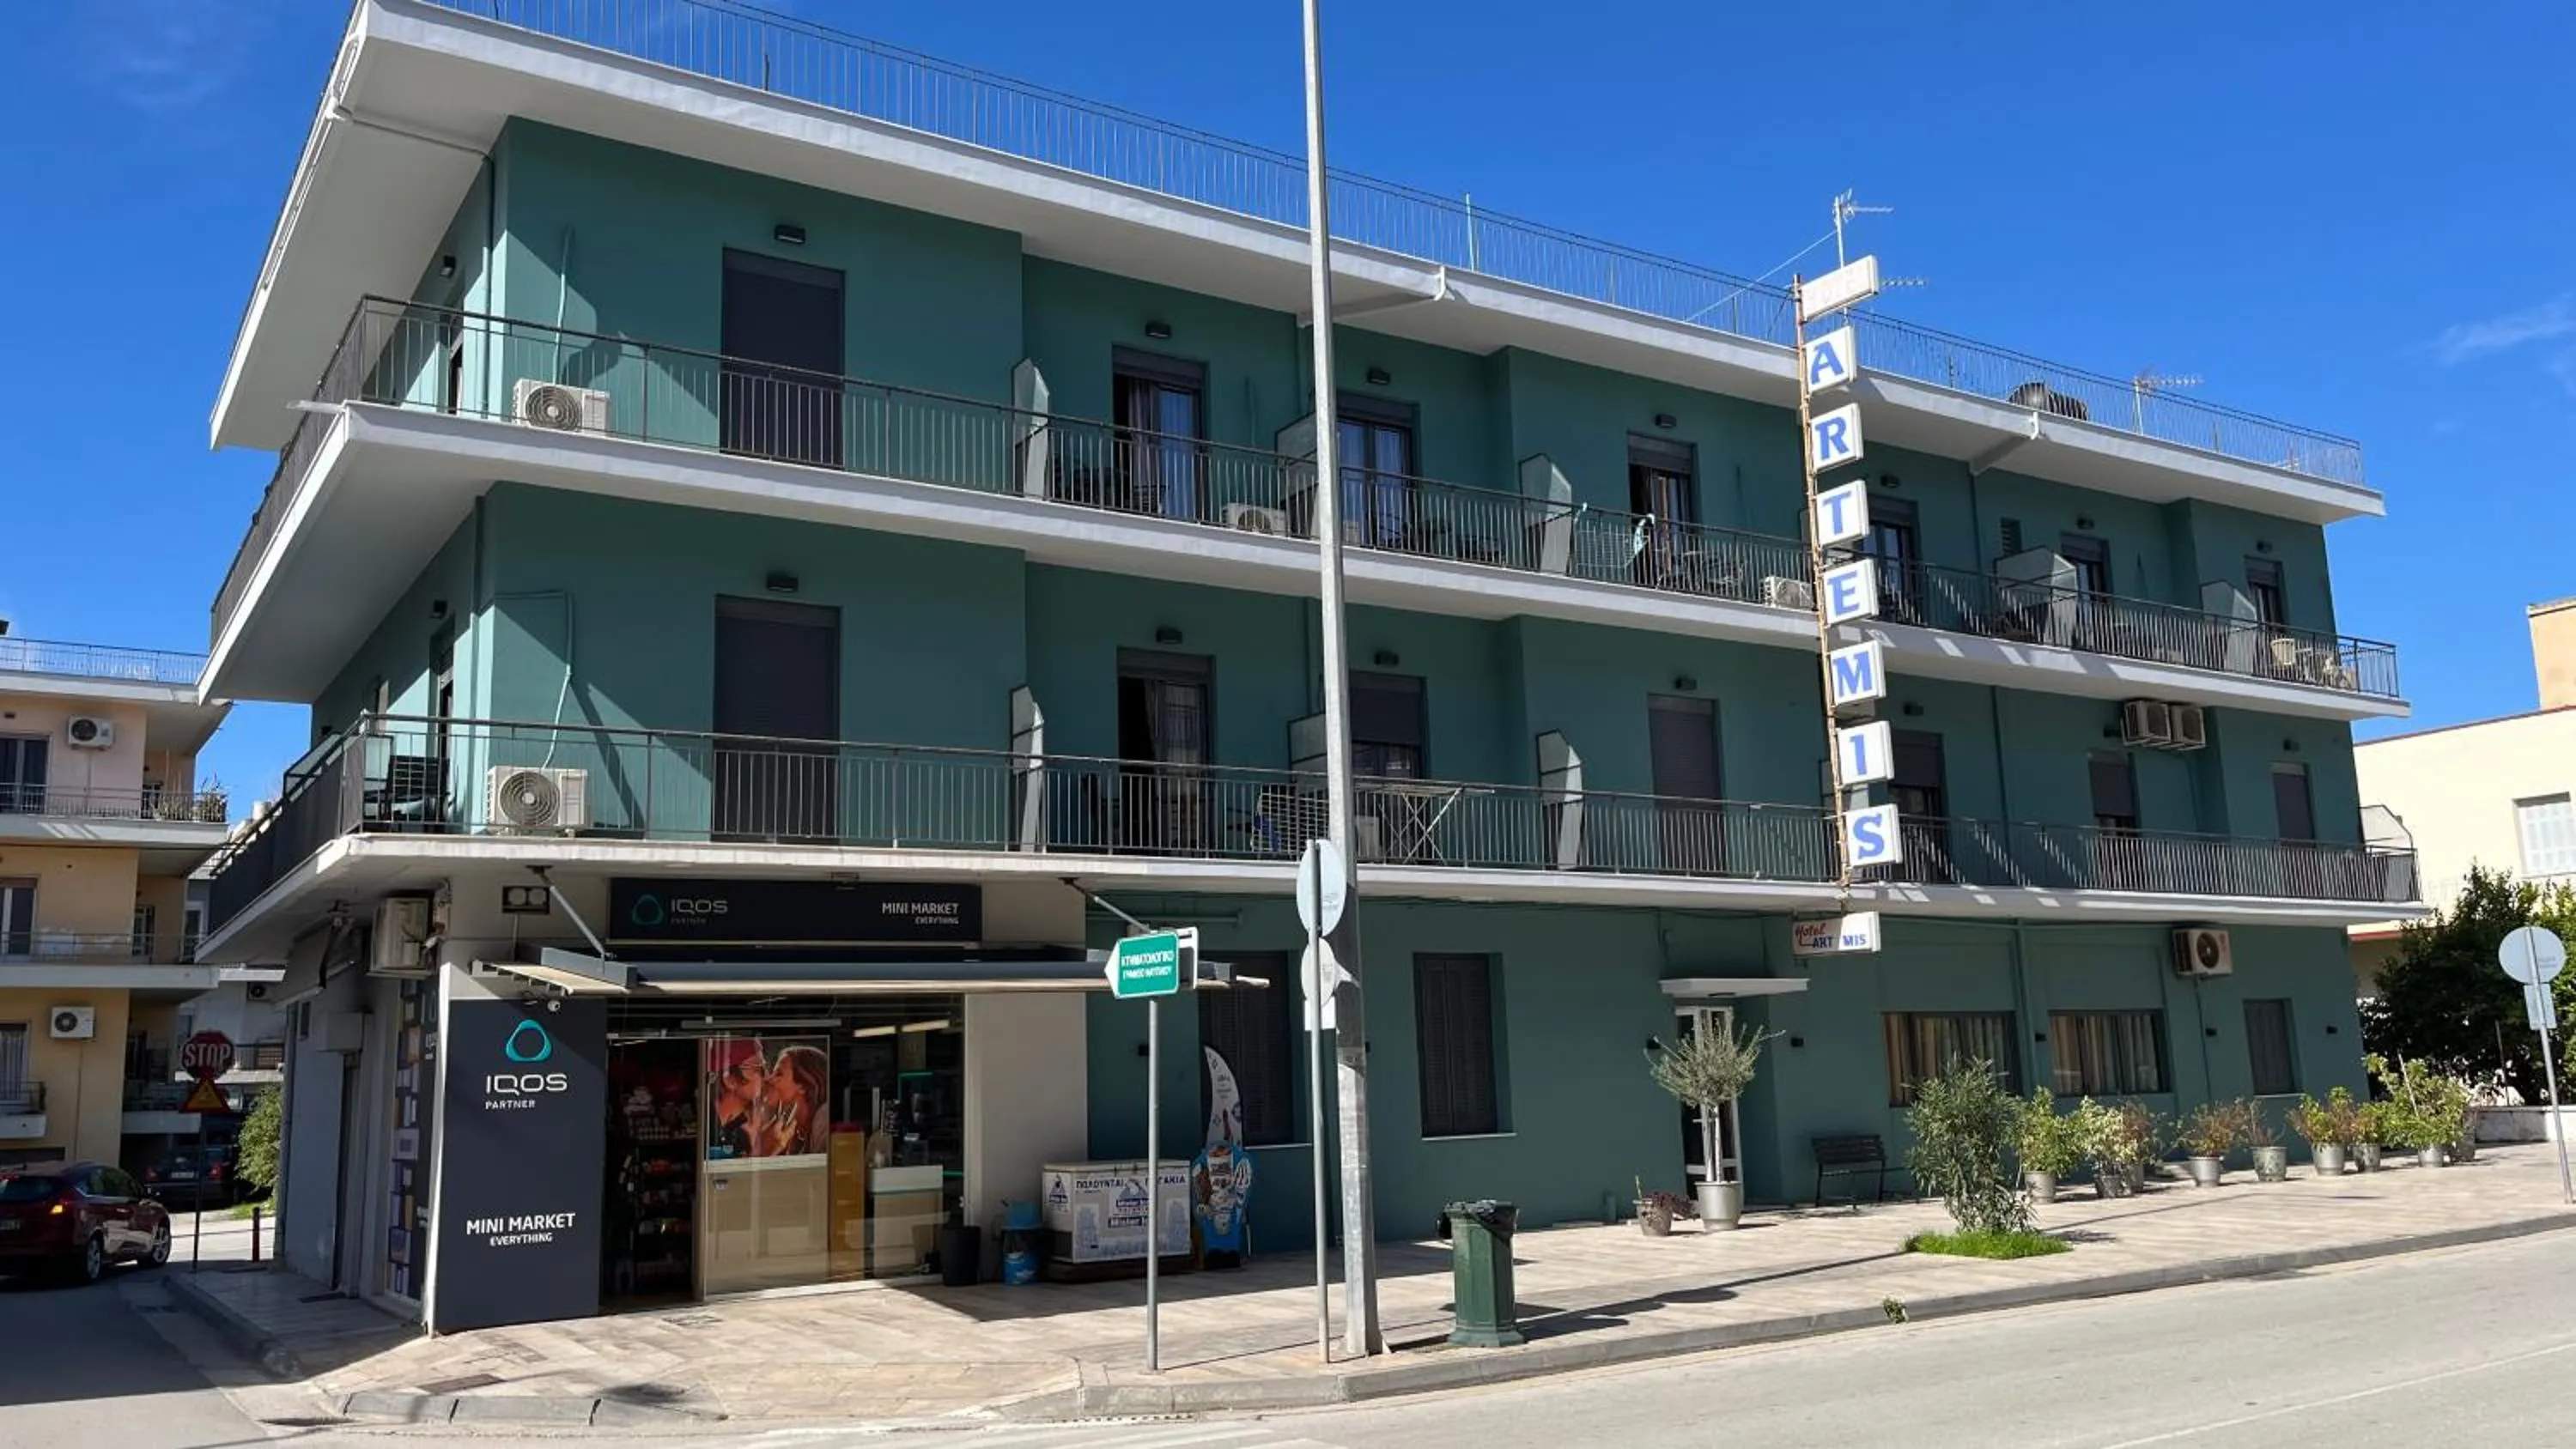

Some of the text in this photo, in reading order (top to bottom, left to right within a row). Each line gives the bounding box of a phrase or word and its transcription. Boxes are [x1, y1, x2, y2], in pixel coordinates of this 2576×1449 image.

[1811, 341, 1885, 859] ARTEMIS
[671, 899, 728, 914] IQOS
[882, 902, 959, 914] MINI MARKET
[184, 1044, 231, 1068] STOP
[486, 1073, 568, 1096] IQOS
[485, 1100, 536, 1109] PARTNER
[466, 1212, 575, 1234] MINI MARKET
[490, 1232, 553, 1246] EVERYTHING
